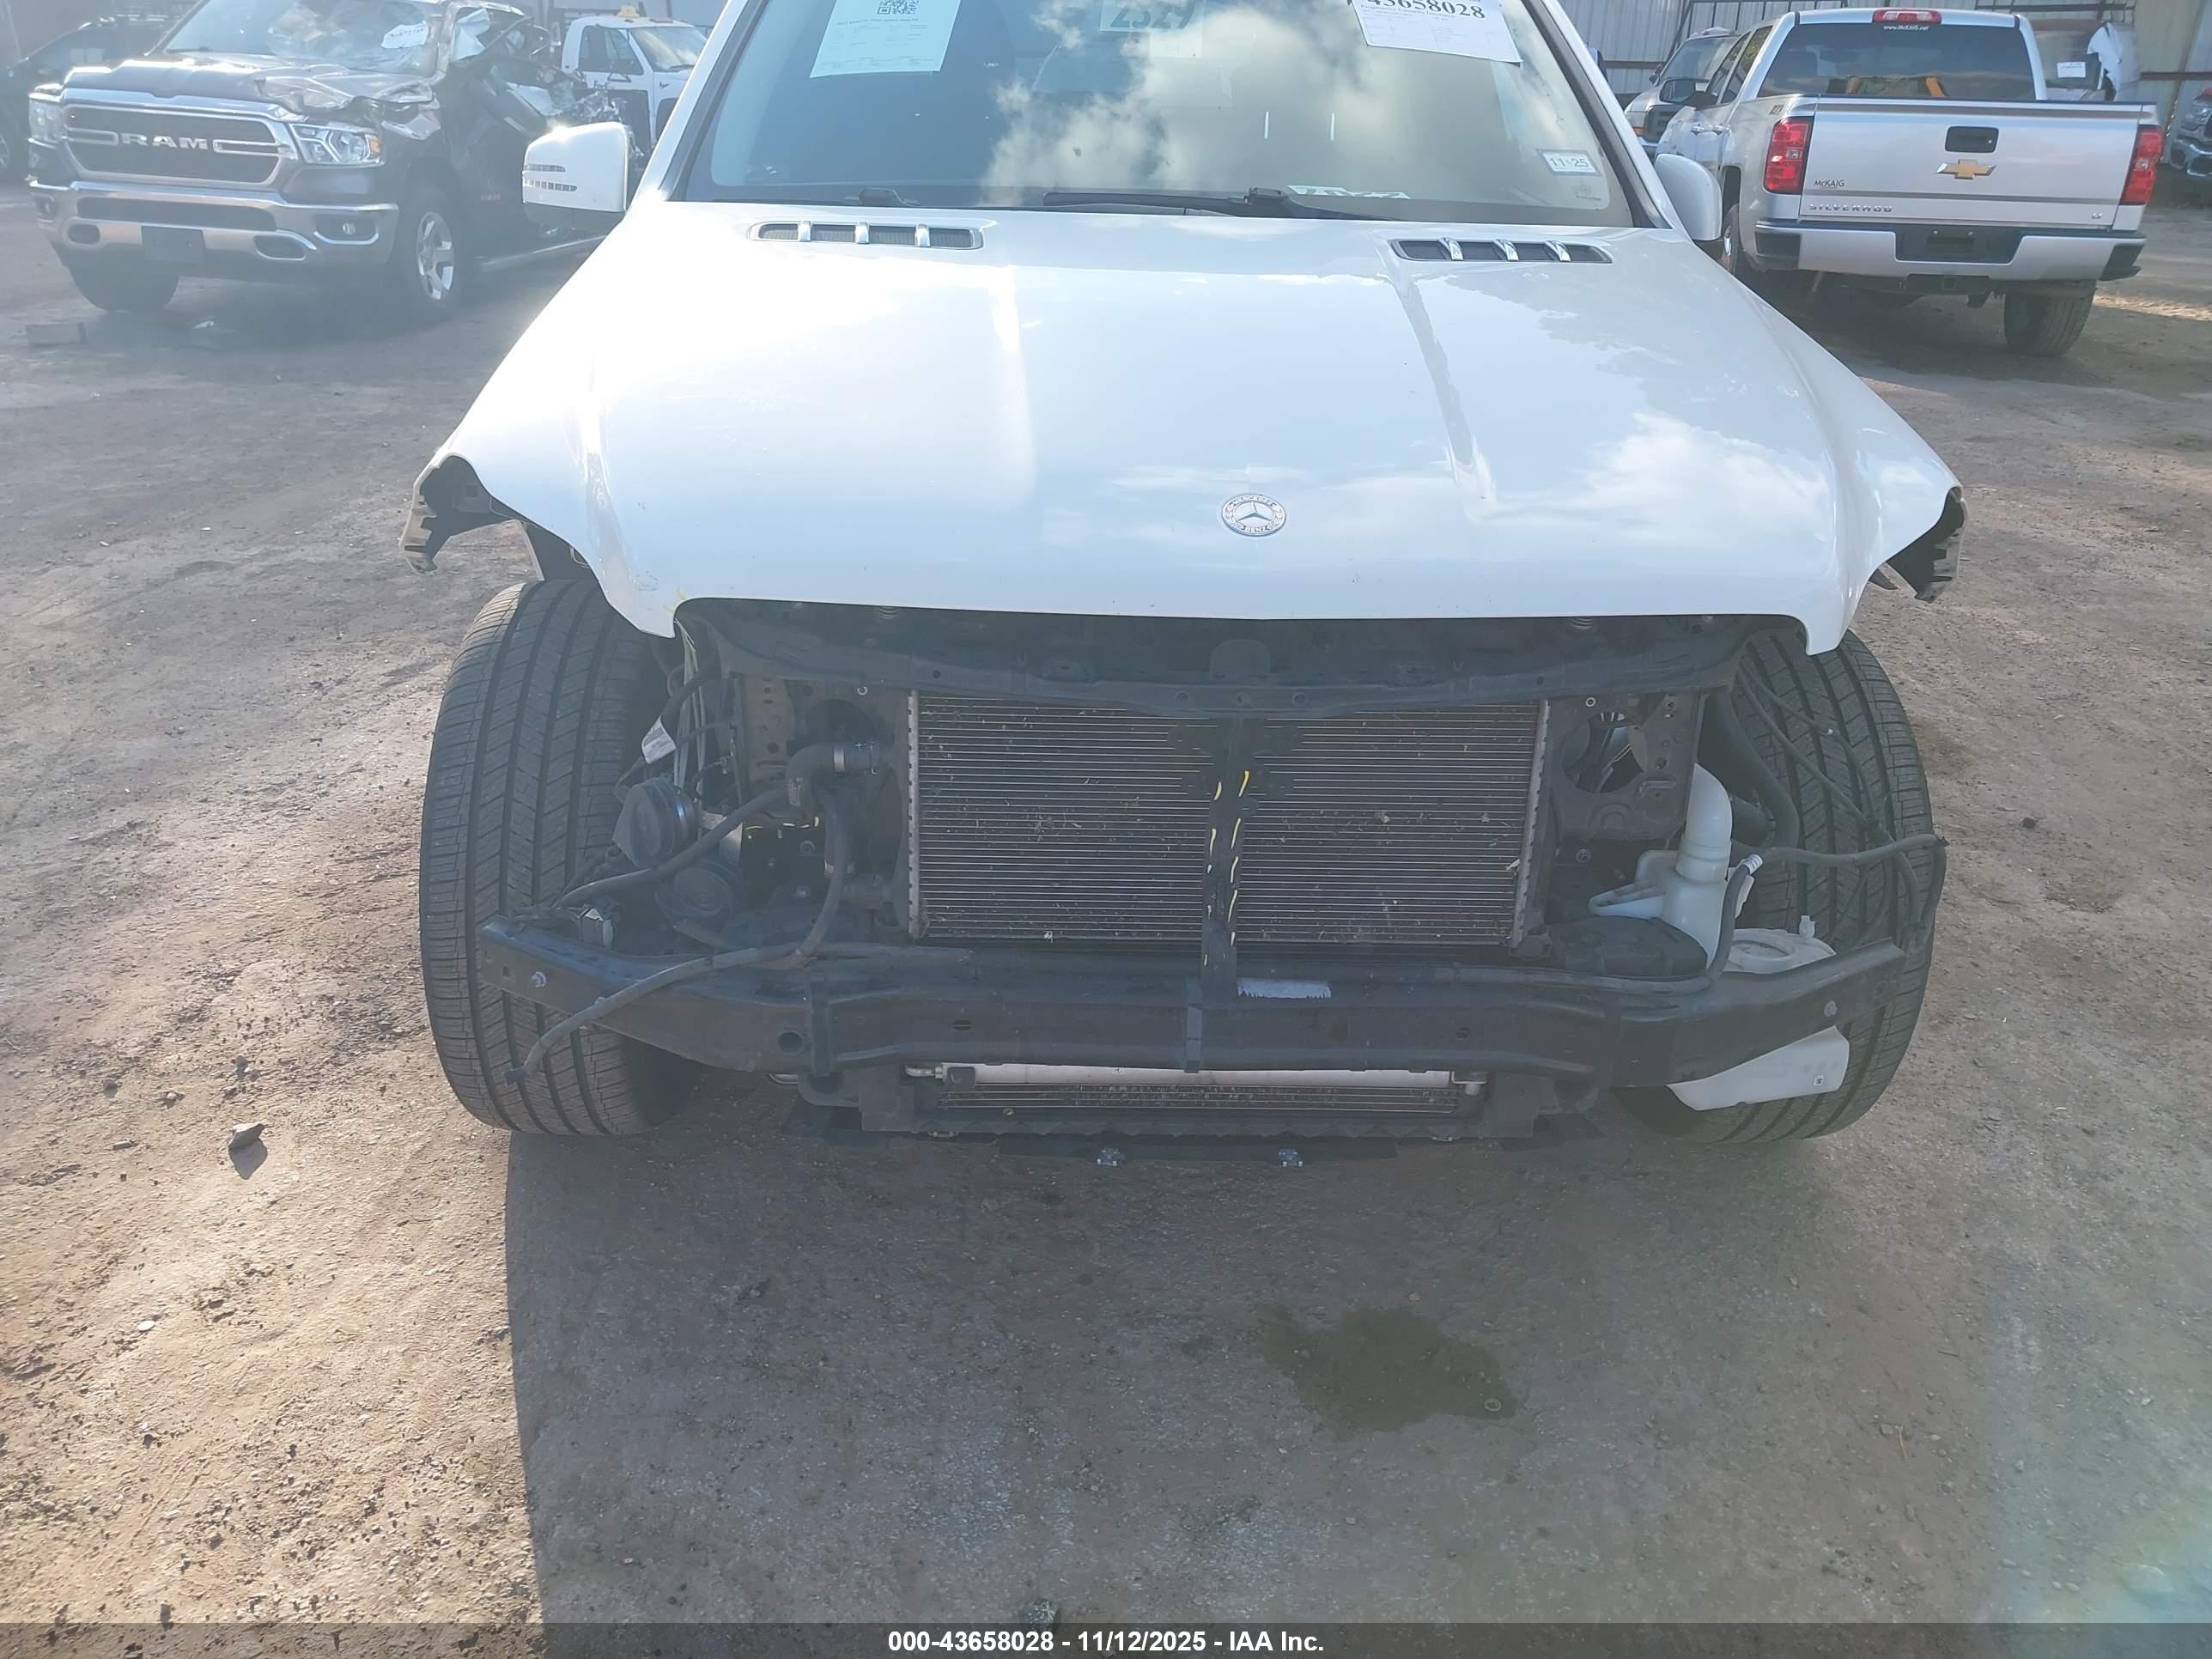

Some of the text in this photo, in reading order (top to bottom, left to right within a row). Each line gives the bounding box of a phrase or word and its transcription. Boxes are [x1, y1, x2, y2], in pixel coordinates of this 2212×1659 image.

[121, 132, 208, 150] RAM
[1814, 179, 1845, 187] McKAIG
[1808, 204, 1894, 213] SILVERADO
